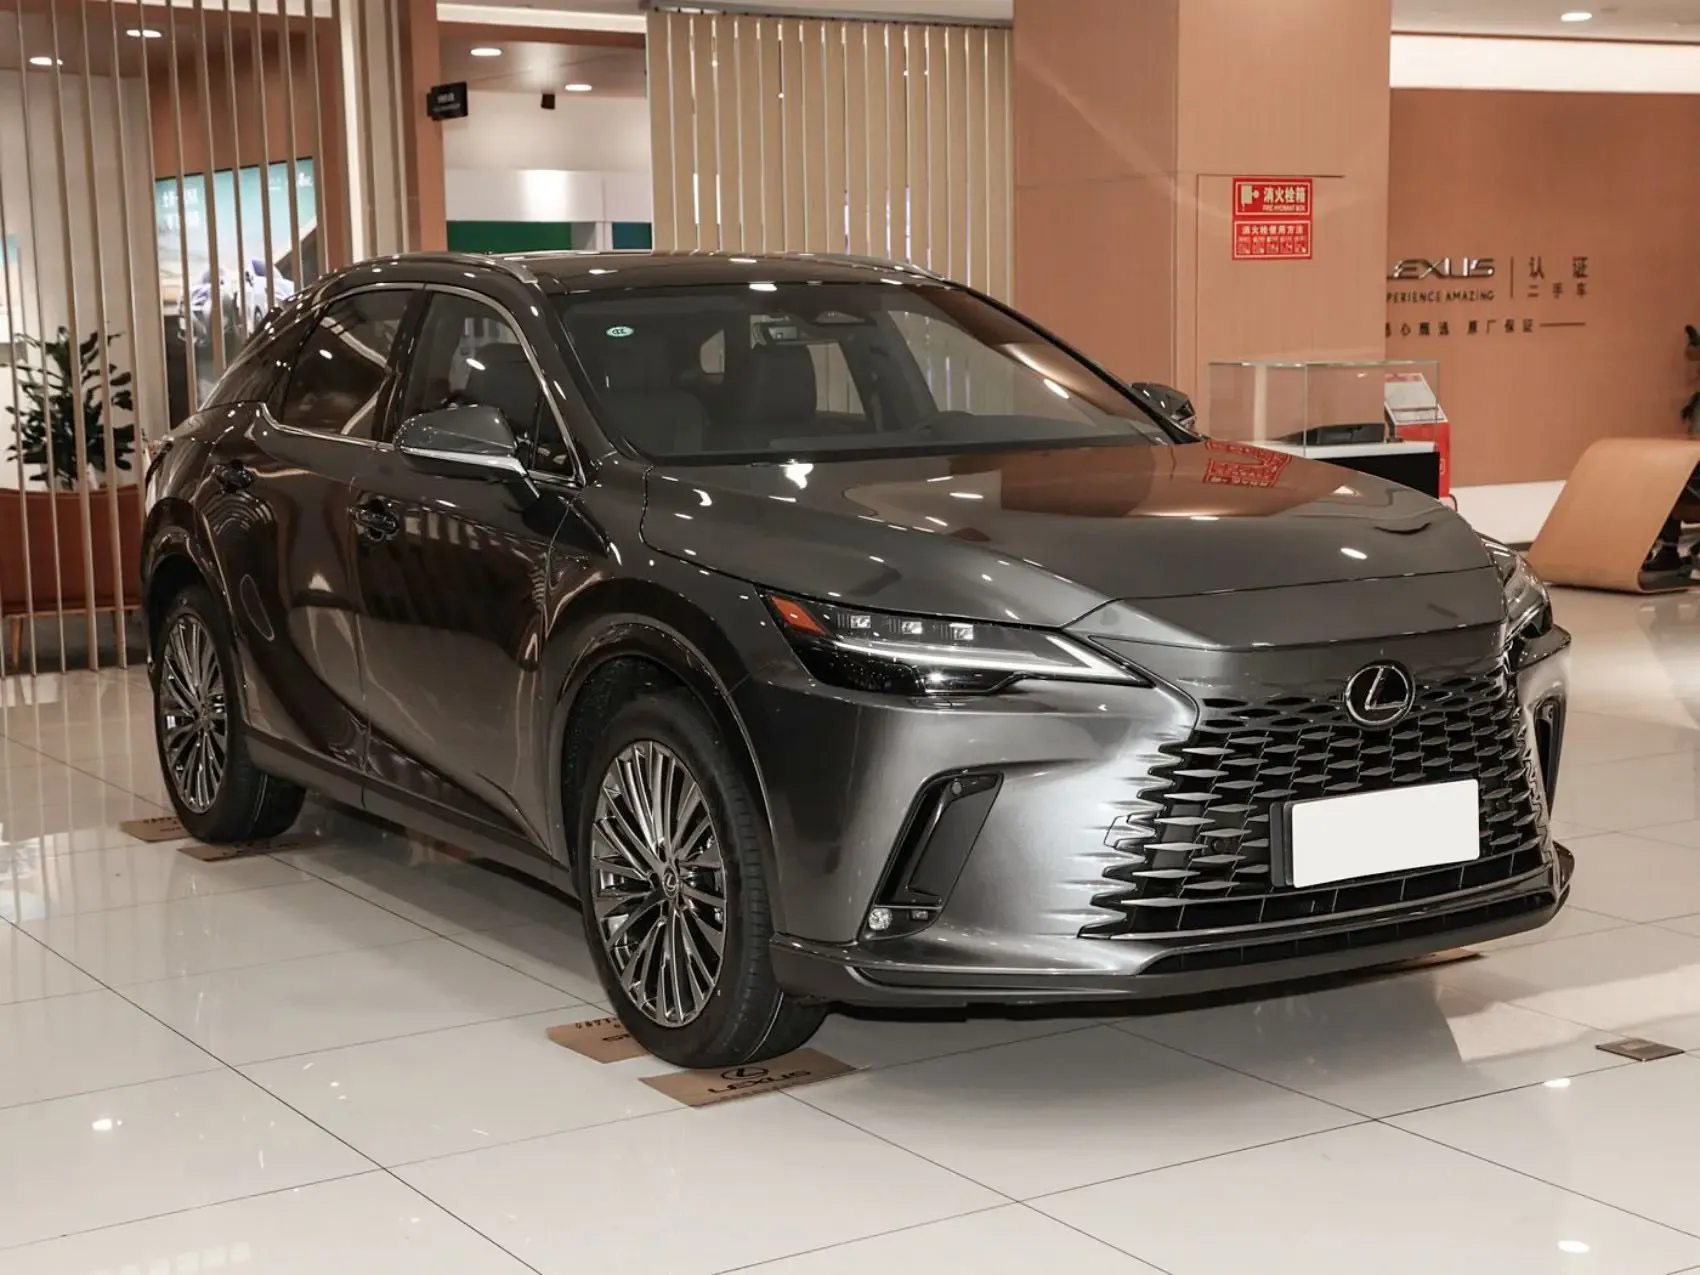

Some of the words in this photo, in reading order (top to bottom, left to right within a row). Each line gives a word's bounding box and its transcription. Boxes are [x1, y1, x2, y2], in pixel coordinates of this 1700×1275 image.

[1446, 289, 1495, 302] AMAZING
[1527, 282, 1588, 300] 二手车
